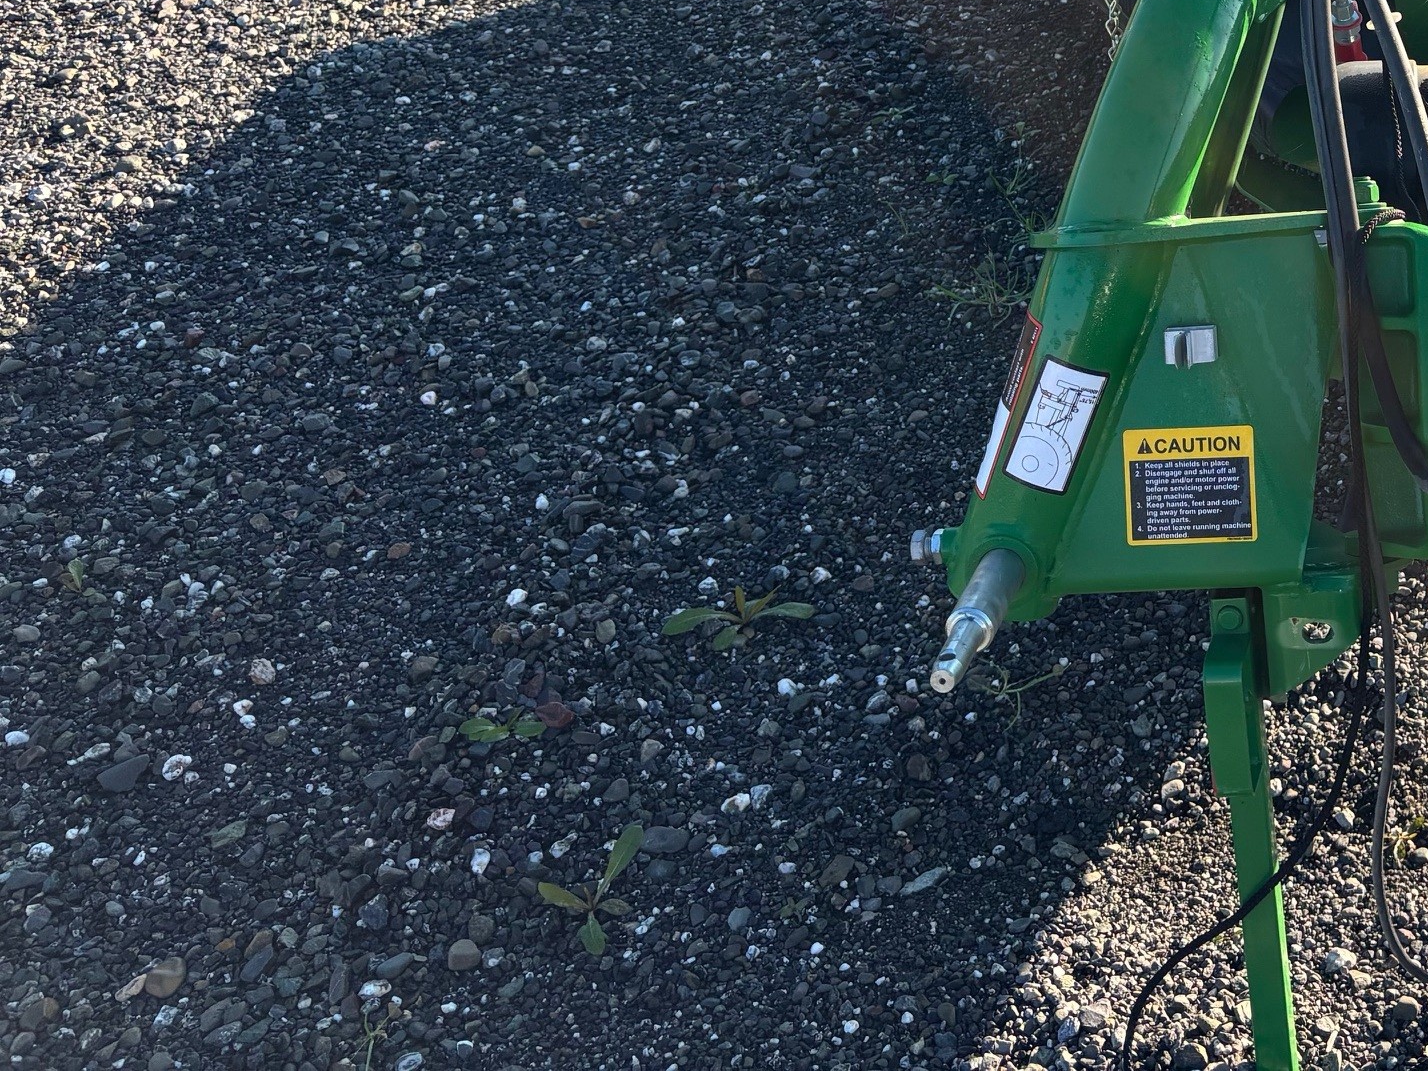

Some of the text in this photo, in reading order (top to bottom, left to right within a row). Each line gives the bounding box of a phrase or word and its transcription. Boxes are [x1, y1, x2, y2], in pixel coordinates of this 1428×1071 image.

[1154, 436, 1240, 454] CAUTION
[1145, 462, 1163, 470] Keep
[1145, 469, 1182, 477] Disengage
[1147, 501, 1164, 509] Keep
[1166, 500, 1190, 508] hands,
